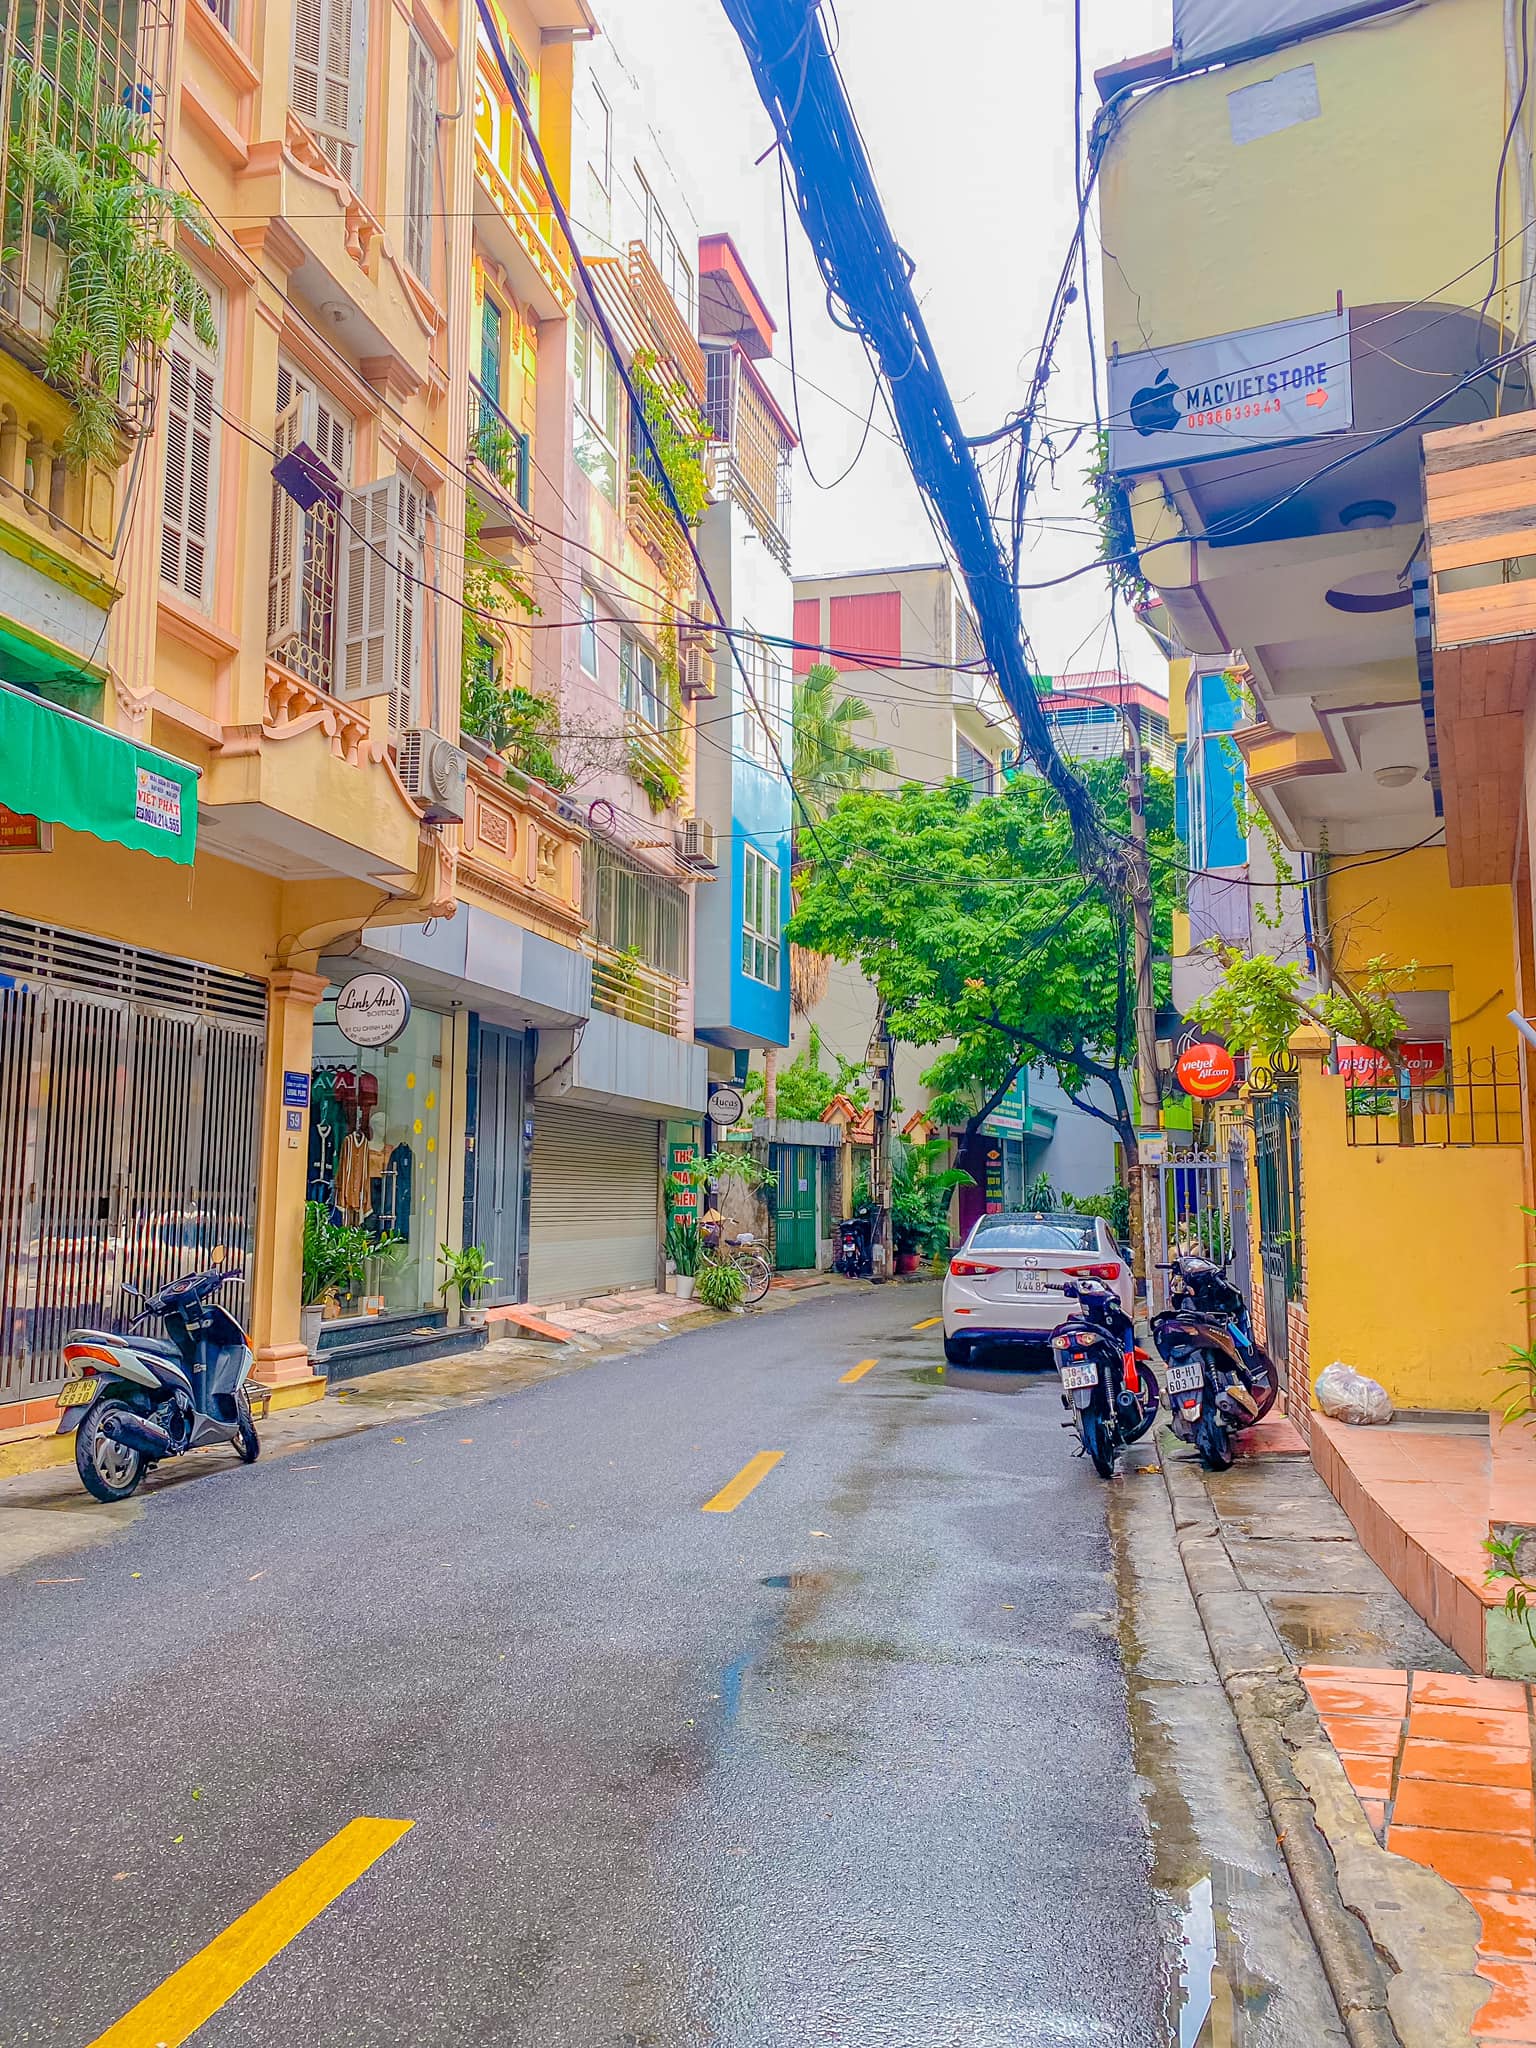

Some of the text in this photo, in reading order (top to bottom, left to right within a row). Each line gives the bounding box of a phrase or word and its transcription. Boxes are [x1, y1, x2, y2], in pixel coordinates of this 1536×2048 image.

[1186, 362, 1328, 409] MACVIETSTORE
[338, 987, 396, 1012] Linh Anh
[289, 1113, 300, 1127] 59
[1171, 1365, 1196, 1380] 18-H1
